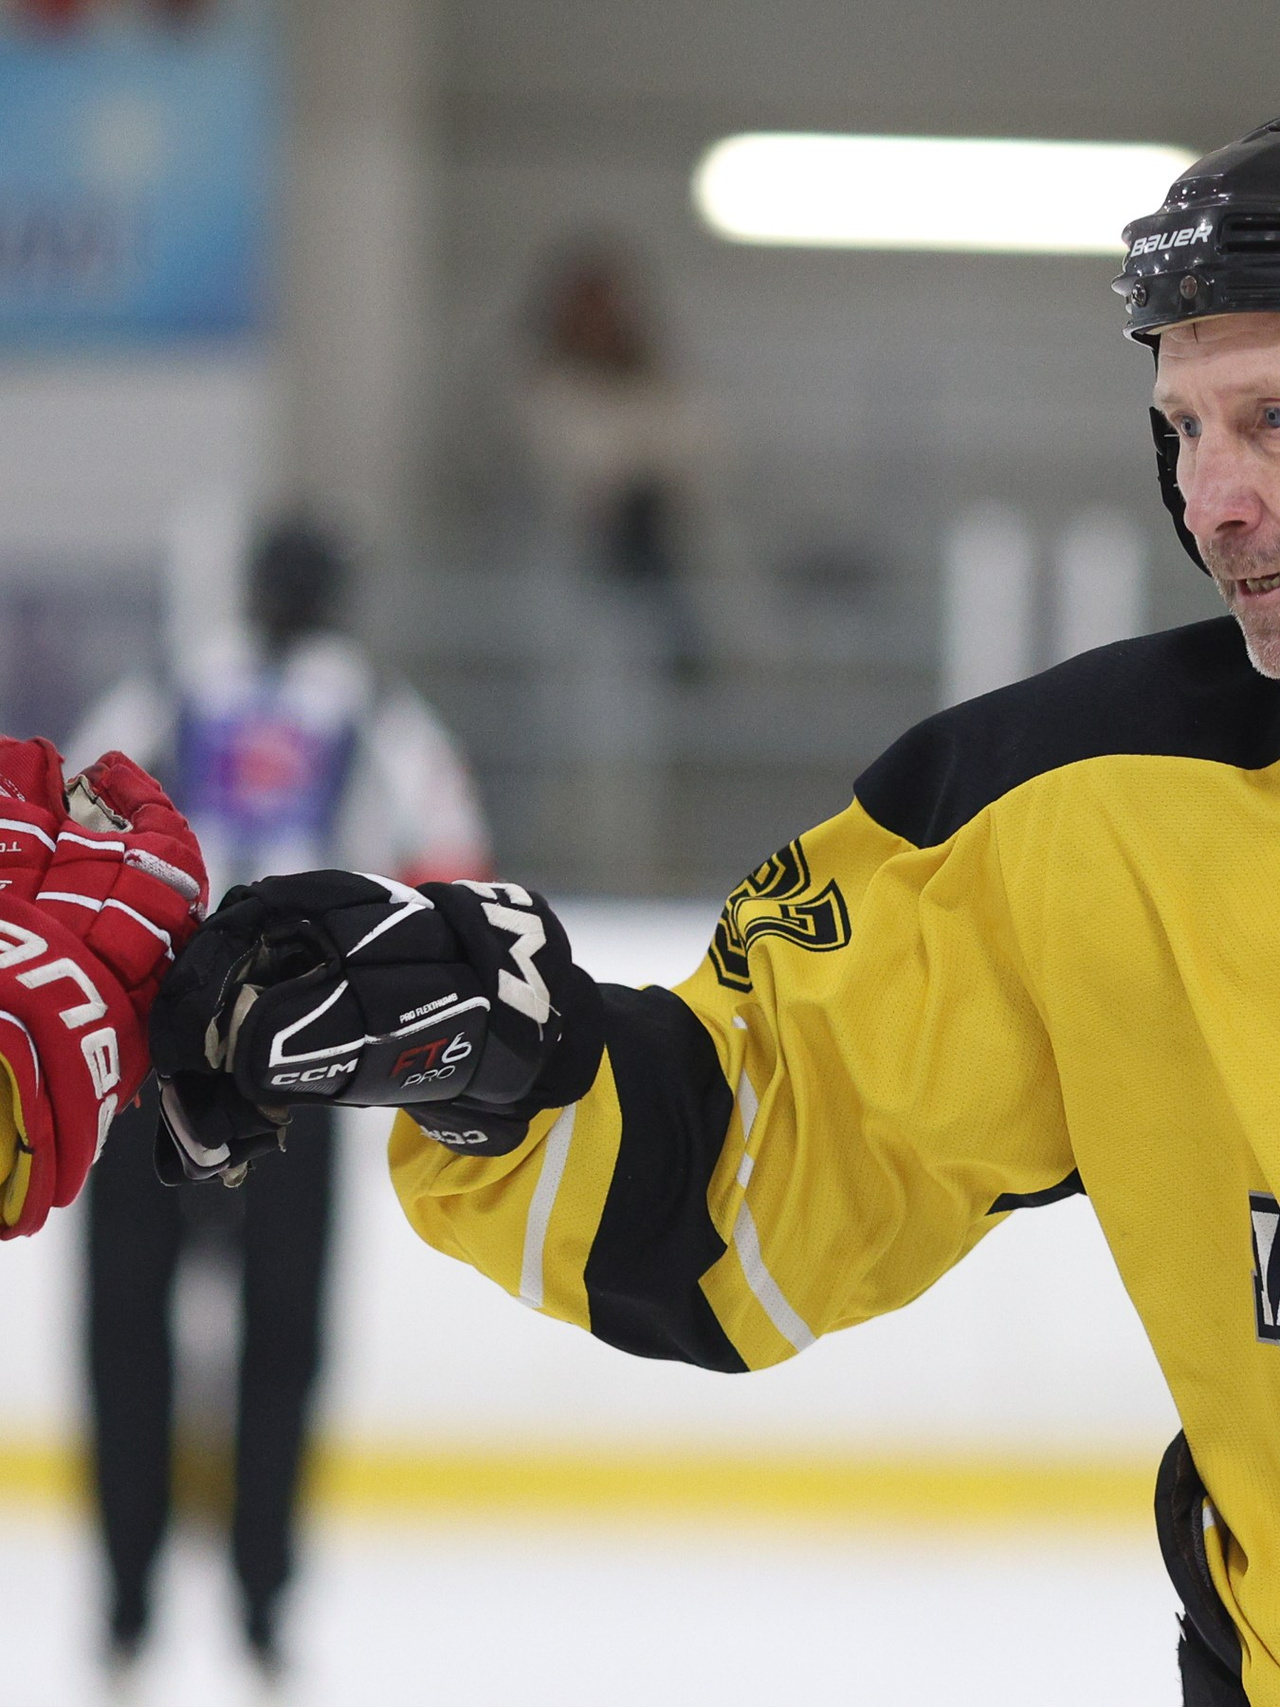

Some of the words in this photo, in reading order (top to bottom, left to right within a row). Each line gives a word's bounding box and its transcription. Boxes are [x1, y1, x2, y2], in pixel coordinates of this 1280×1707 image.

[1130, 222, 1213, 257] BAUER
[390, 1031, 473, 1078] FT6
[270, 1057, 359, 1086] CCM
[400, 1065, 456, 1089] PRO
